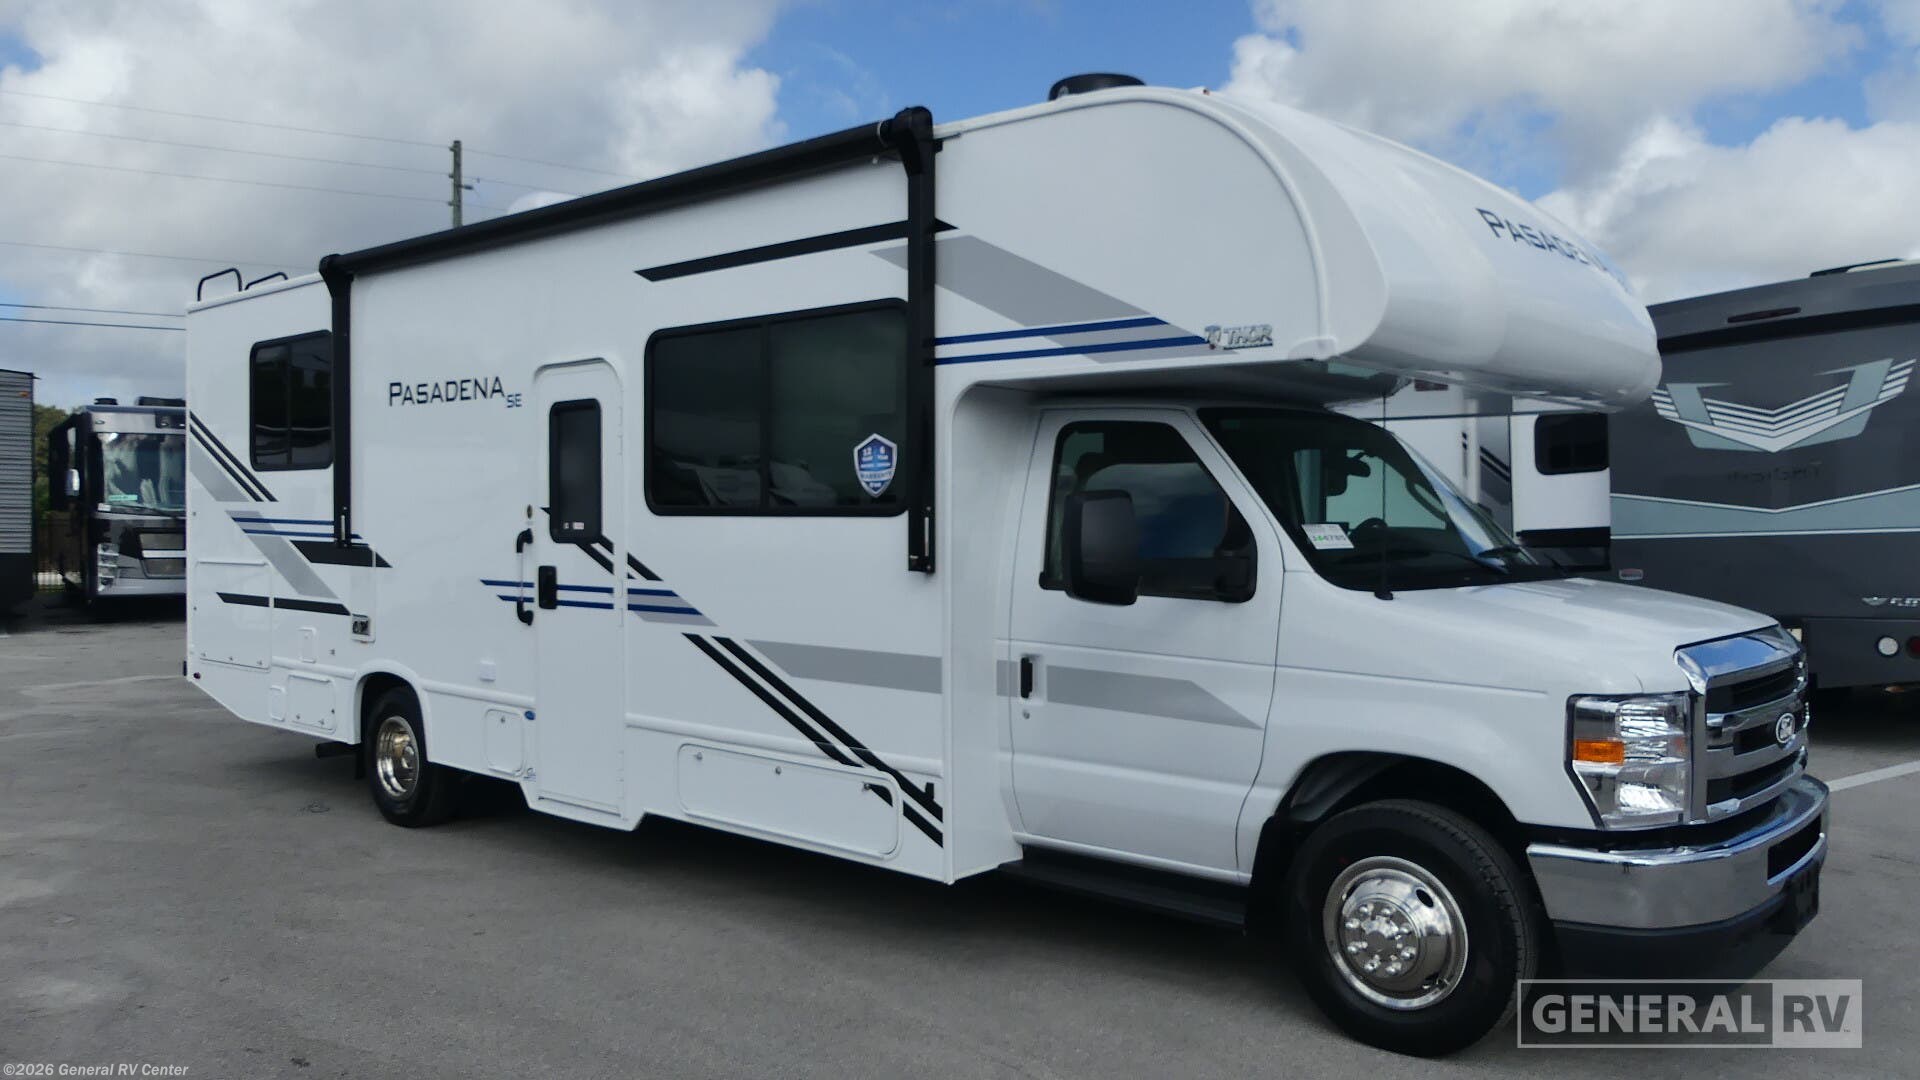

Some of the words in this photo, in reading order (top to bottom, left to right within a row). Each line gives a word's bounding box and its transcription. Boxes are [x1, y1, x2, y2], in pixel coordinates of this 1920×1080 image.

[1222, 324, 1273, 346] THOR
[388, 376, 506, 407] PASADENA
[506, 393, 523, 408] SE
